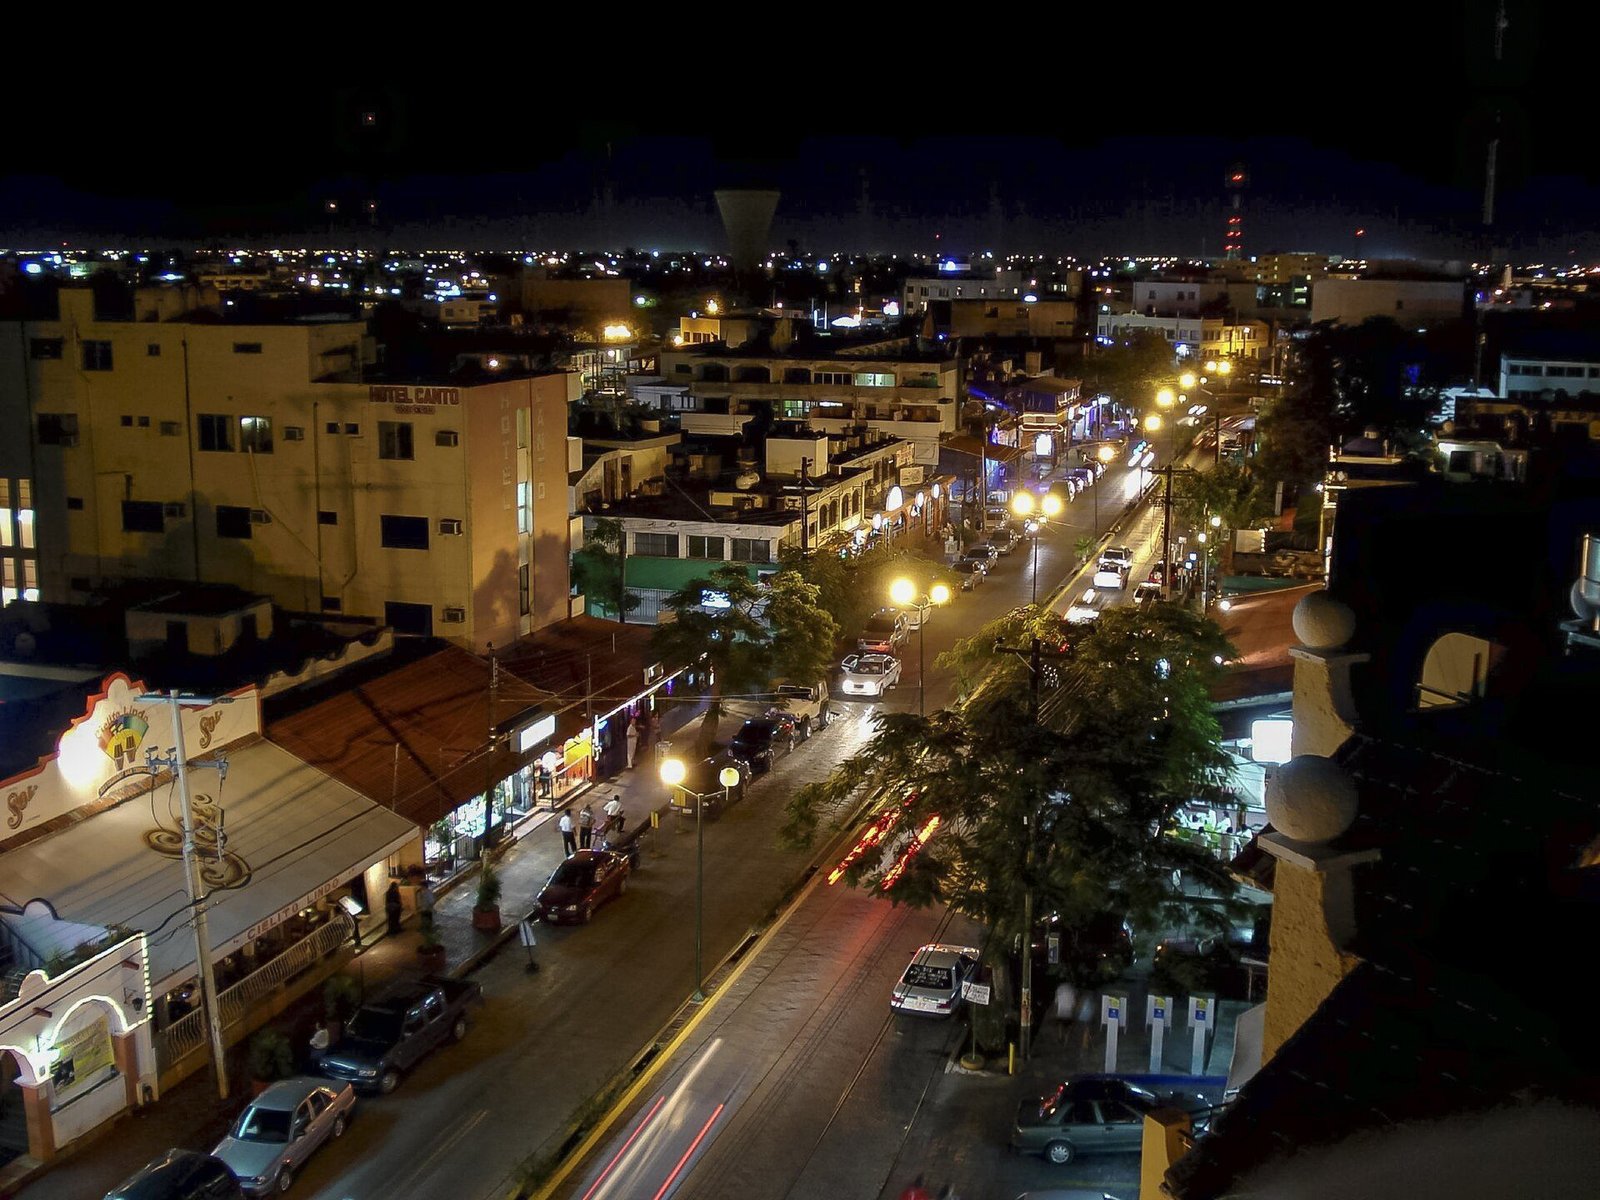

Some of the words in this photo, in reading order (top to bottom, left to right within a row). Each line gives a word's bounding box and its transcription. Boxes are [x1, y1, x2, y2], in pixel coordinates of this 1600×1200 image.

[369, 387, 414, 404] HOTEL
[414, 387, 459, 405] CANTO
[247, 903, 299, 940] CIELITO
[306, 878, 339, 904] LINDO
